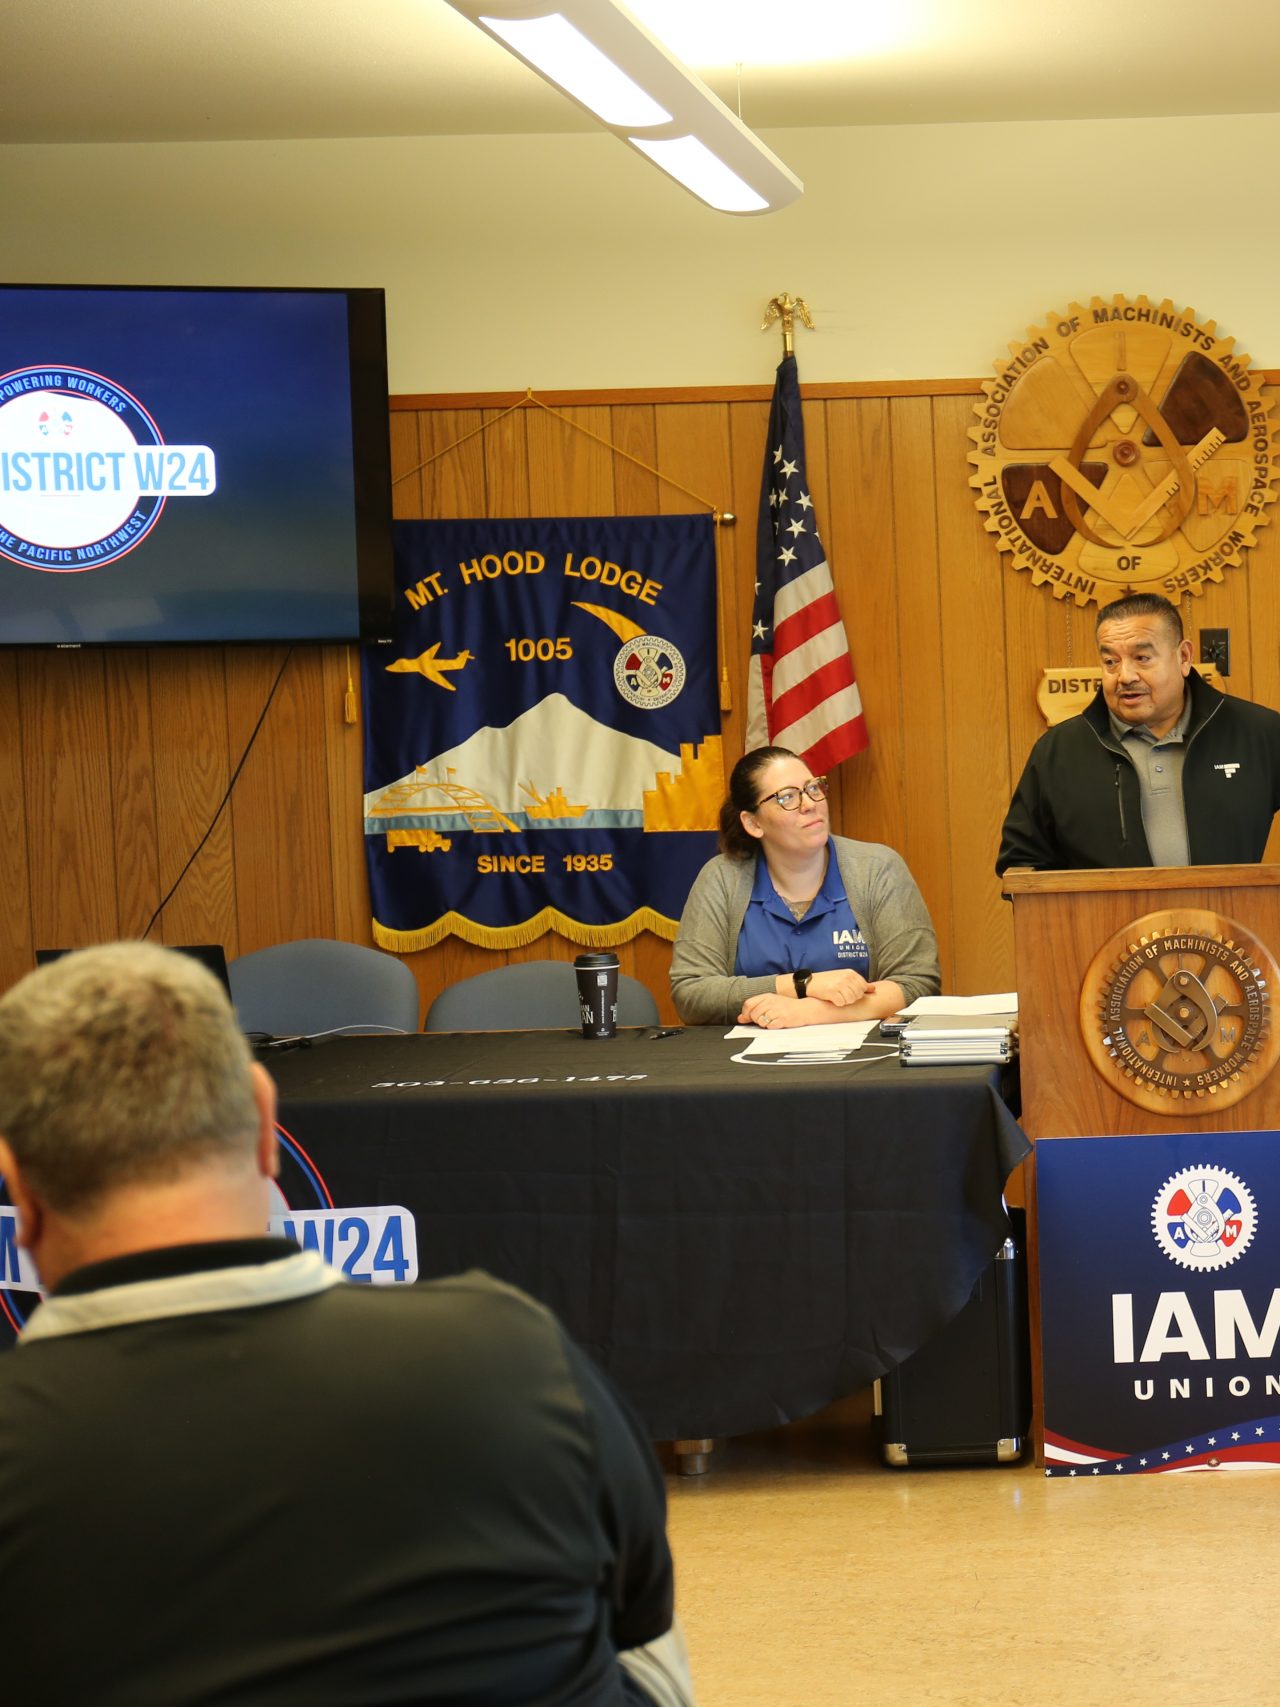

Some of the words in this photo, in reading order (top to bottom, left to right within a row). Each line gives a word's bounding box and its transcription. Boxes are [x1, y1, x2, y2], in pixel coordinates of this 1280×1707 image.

[1057, 316, 1081, 338] OF
[1093, 306, 1216, 352] MACHINISTS
[1218, 353, 1251, 392] AND
[67, 376, 126, 413] WORKERS
[982, 337, 1050, 457] ASSOCIATION
[0, 452, 125, 492] ISTRICT
[133, 452, 210, 492] W24
[1244, 400, 1269, 518] AEROSPACE
[1019, 480, 1058, 519] A
[1197, 476, 1237, 516] M
[0, 529, 15, 548] HE
[18, 542, 72, 561] PACIFIC
[76, 510, 147, 560] NORTHWEST
[983, 475, 1096, 595] INTERNATIONAL
[404, 571, 449, 611] MT.
[459, 550, 545, 586] HOOD
[564, 553, 664, 606] LODGE
[1117, 556, 1142, 571] OF
[1163, 529, 1245, 594] WORKERS
[504, 637, 574, 662] 1005
[477, 855, 546, 874] SINCE
[562, 854, 614, 873] 1935
[1145, 944, 1158, 959] OF
[1164, 938, 1228, 961] MACHINISTS
[1110, 955, 1144, 1021] ASSOCIATION
[1229, 960, 1249, 981] AND
[1241, 985, 1259, 1051] AEROSPACE
[1113, 1027, 1177, 1086] INTERNATIONAL
[1197, 1053, 1244, 1082] WORKERS
[1173, 1226, 1185, 1240] A
[1225, 1225, 1237, 1238] M
